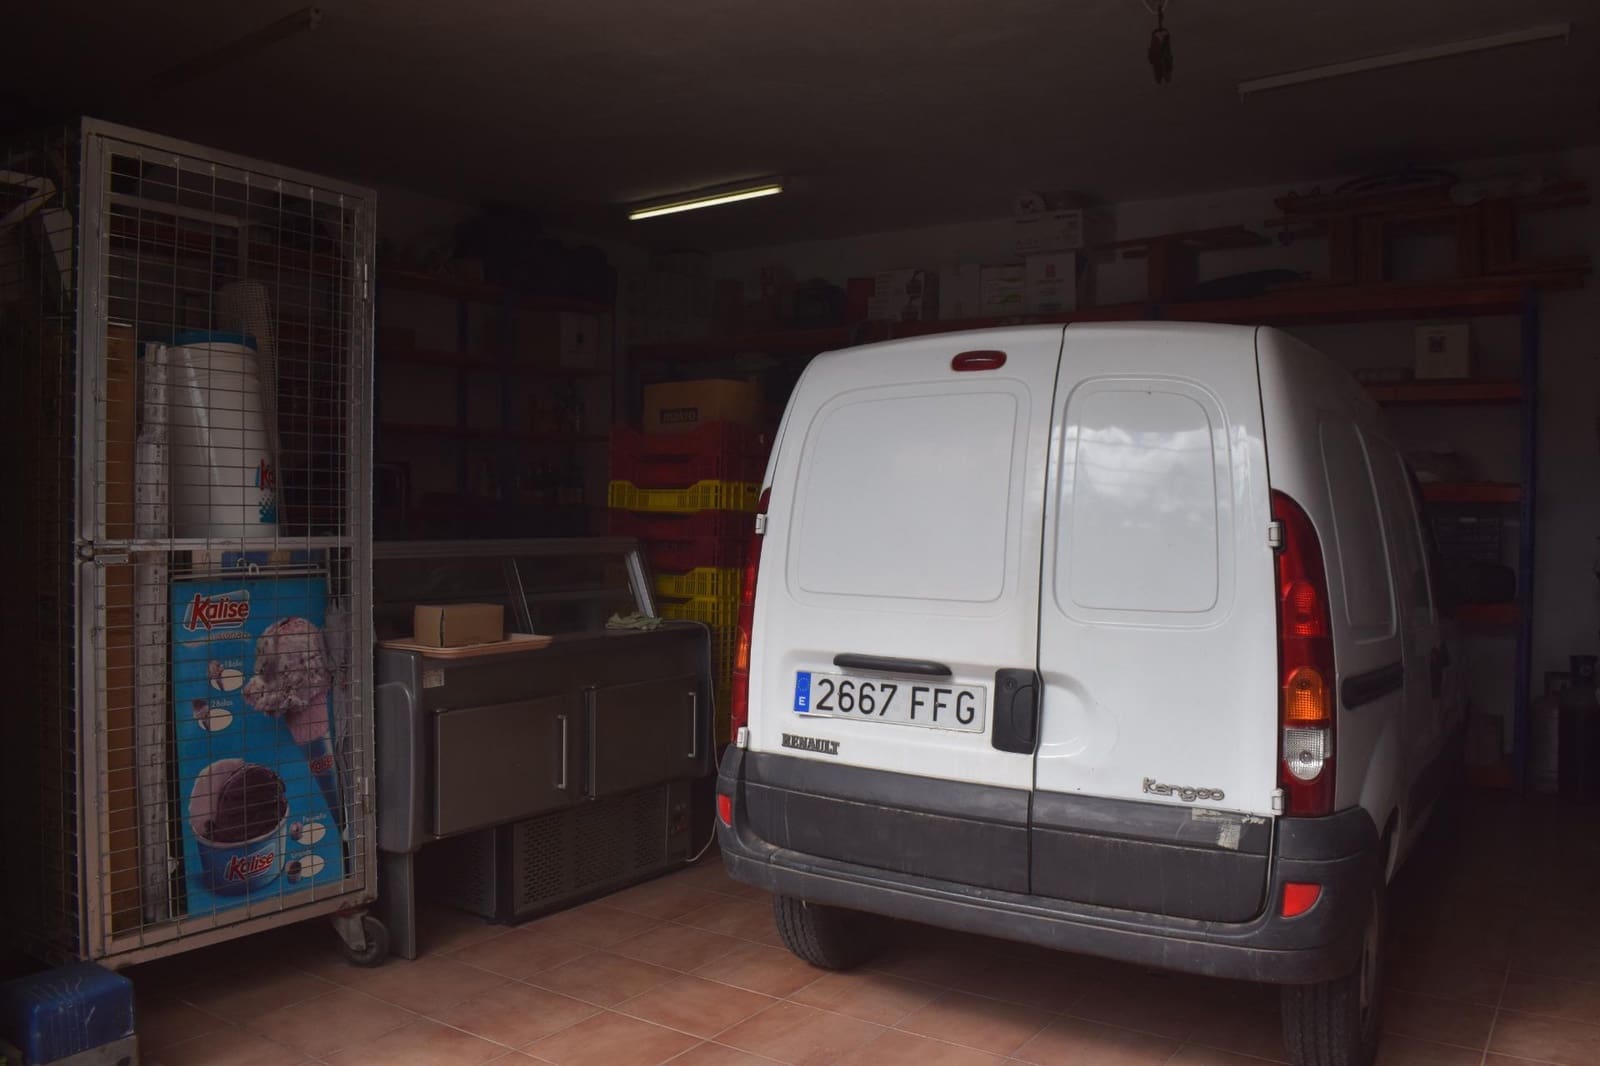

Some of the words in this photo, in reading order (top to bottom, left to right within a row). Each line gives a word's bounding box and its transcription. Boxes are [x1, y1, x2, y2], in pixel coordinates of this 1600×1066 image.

[190, 593, 249, 630] Kalise
[799, 696, 806, 706] E
[816, 678, 897, 716] 2667
[910, 686, 975, 725] FFG
[781, 733, 840, 755] RENAULT
[227, 852, 274, 881] Kalise
